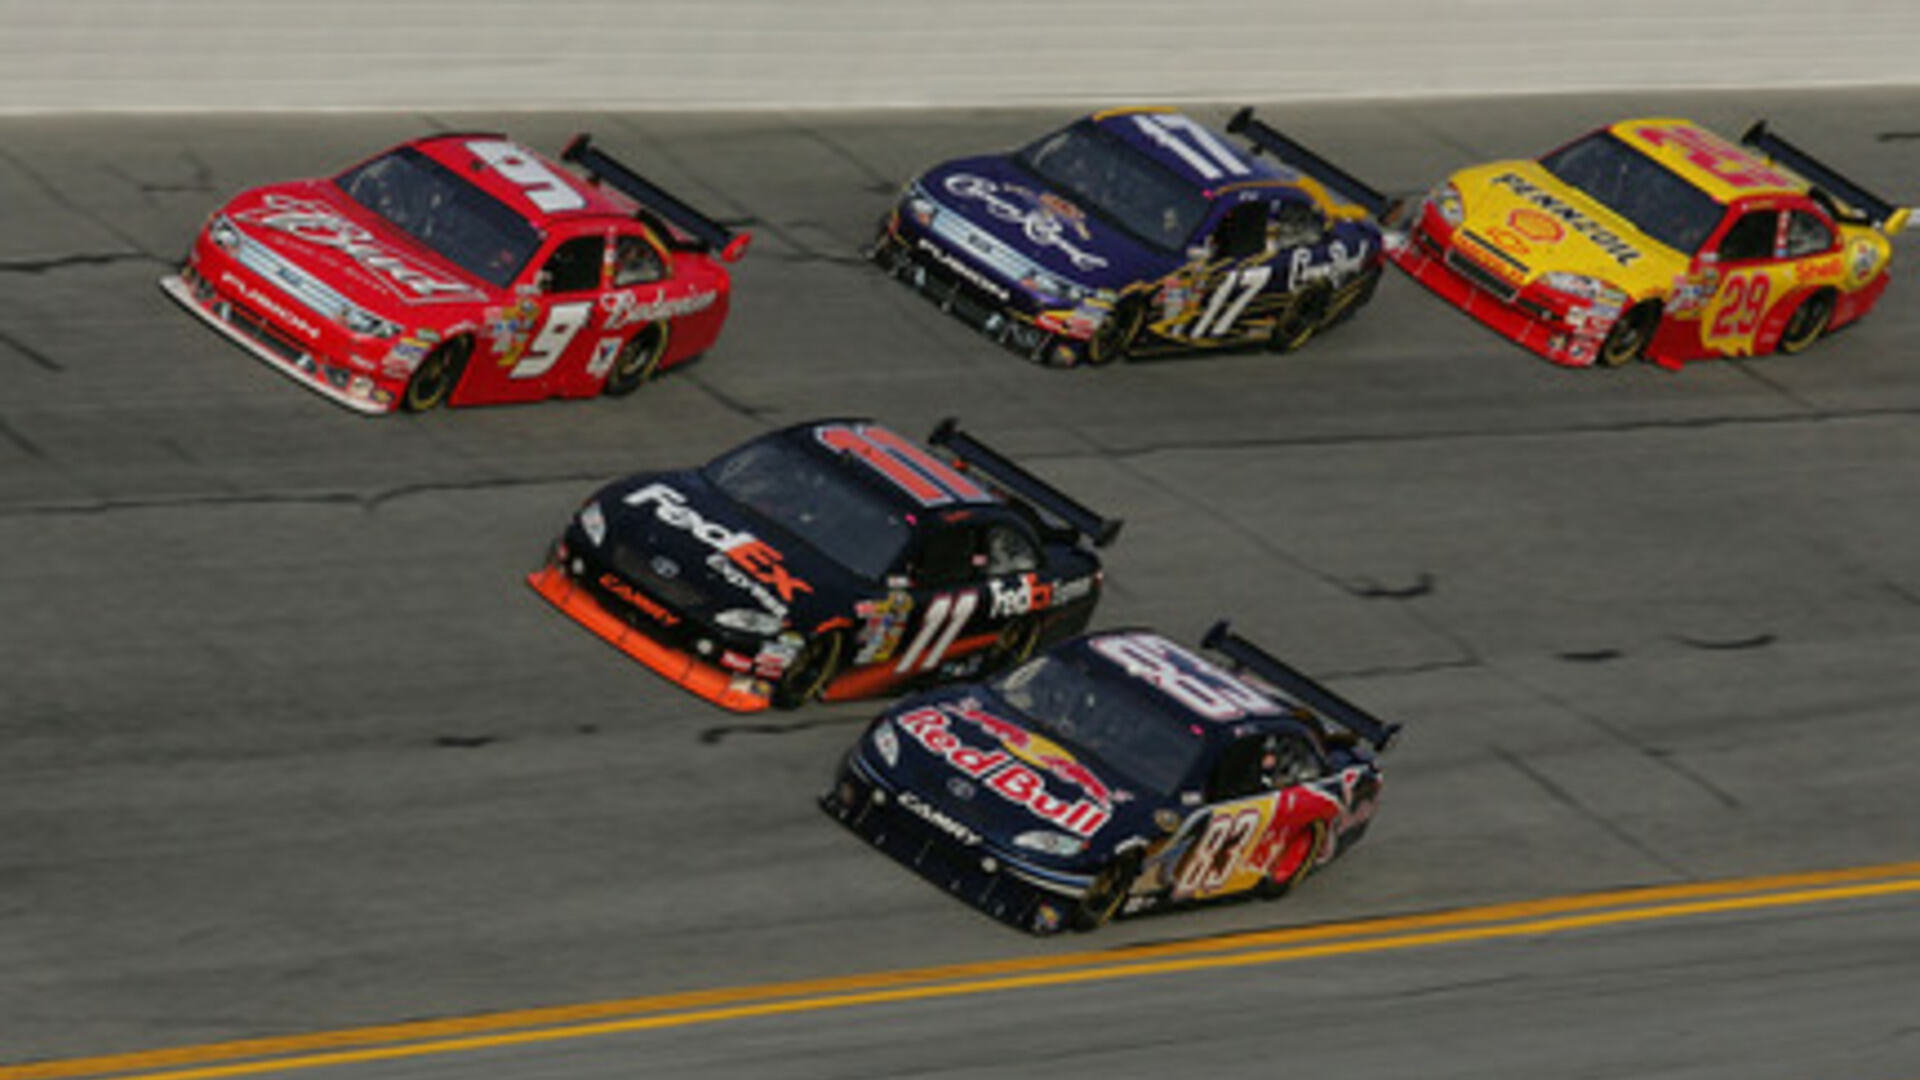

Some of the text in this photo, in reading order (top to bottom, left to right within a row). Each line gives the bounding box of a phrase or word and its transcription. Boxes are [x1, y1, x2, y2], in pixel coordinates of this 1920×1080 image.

[464, 141, 586, 214] 9
[1132, 114, 1250, 178] 17
[1491, 173, 1642, 268] PENNZOIL
[221, 271, 321, 338] FUSION
[602, 286, 717, 329] Budweiser
[1190, 266, 1272, 338] 17
[1710, 272, 1770, 337] 29
[509, 301, 592, 378] 9
[814, 423, 992, 506] 11
[622, 483, 814, 602] FedEx
[599, 573, 680, 626] CAMRY
[706, 554, 788, 617] Express
[988, 573, 1053, 619] FedEx
[895, 588, 979, 673] 11
[897, 706, 1113, 838] Red Bull
[897, 792, 983, 846] CAMRY
[1172, 809, 1262, 893] 83
